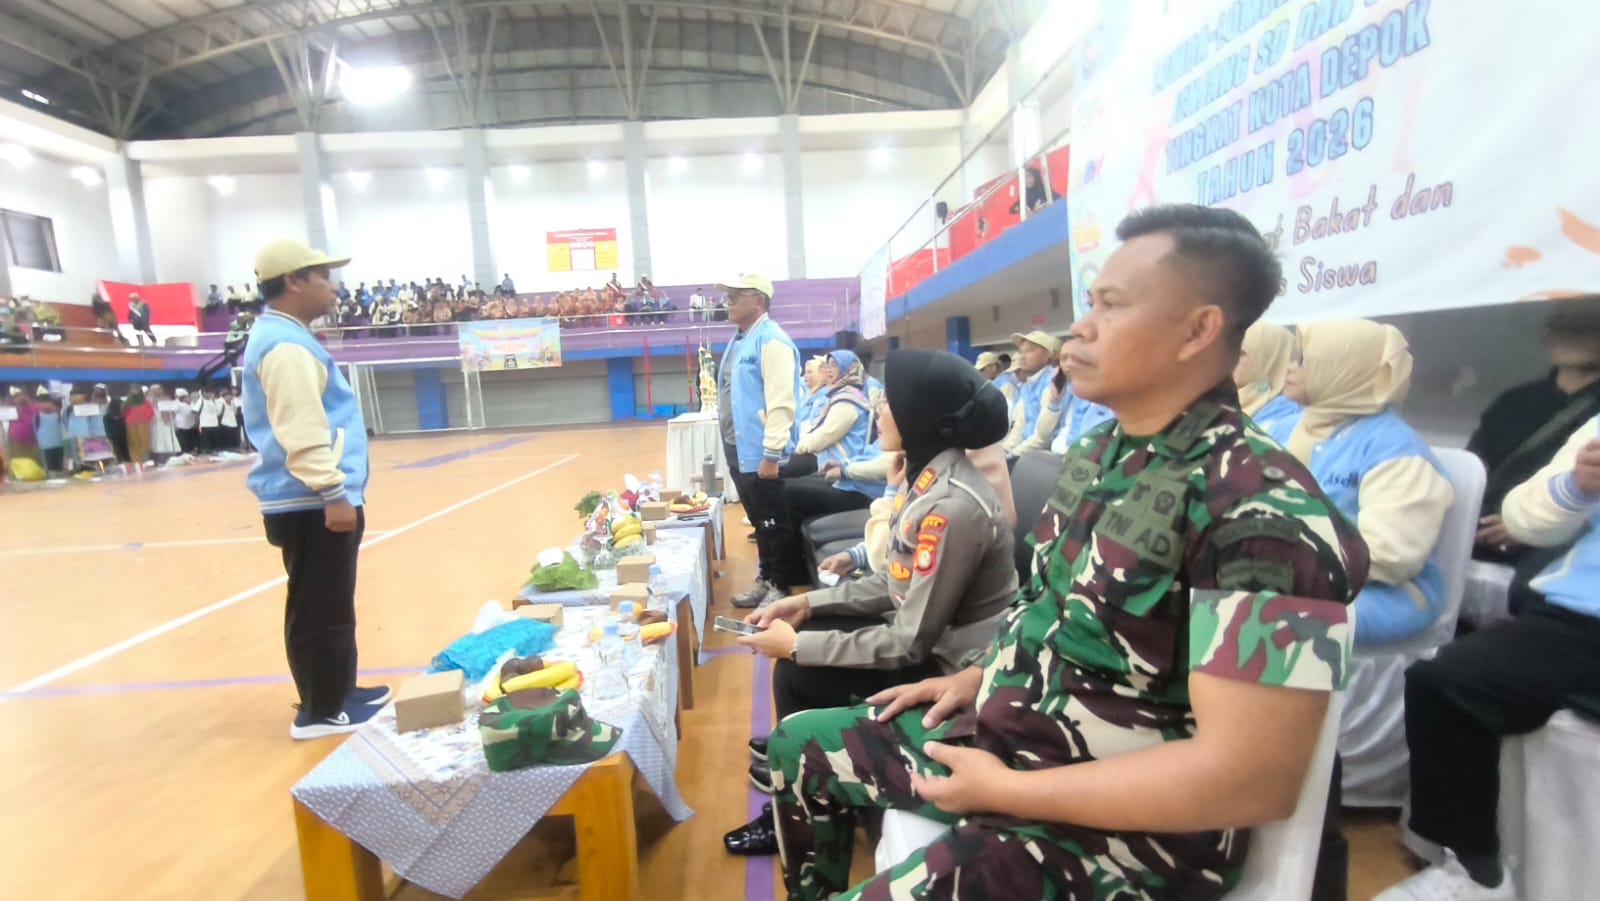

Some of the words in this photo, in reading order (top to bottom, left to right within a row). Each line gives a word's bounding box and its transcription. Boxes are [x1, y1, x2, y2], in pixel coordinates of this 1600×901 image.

[1254, 20, 1290, 73] SD
[1293, 0, 1354, 50] DAN
[1166, 100, 1243, 175] TINGKAT
[1248, 62, 1311, 134] KOTA
[1320, 0, 1431, 98] DEPOK
[1197, 140, 1275, 206] TAHUN
[1286, 96, 1374, 177] 2026
[1293, 184, 1378, 245] Bakat
[1391, 172, 1454, 221] dan
[1297, 256, 1377, 294] Siswa
[1104, 510, 1134, 537] TNI
[1134, 528, 1171, 557] AD
